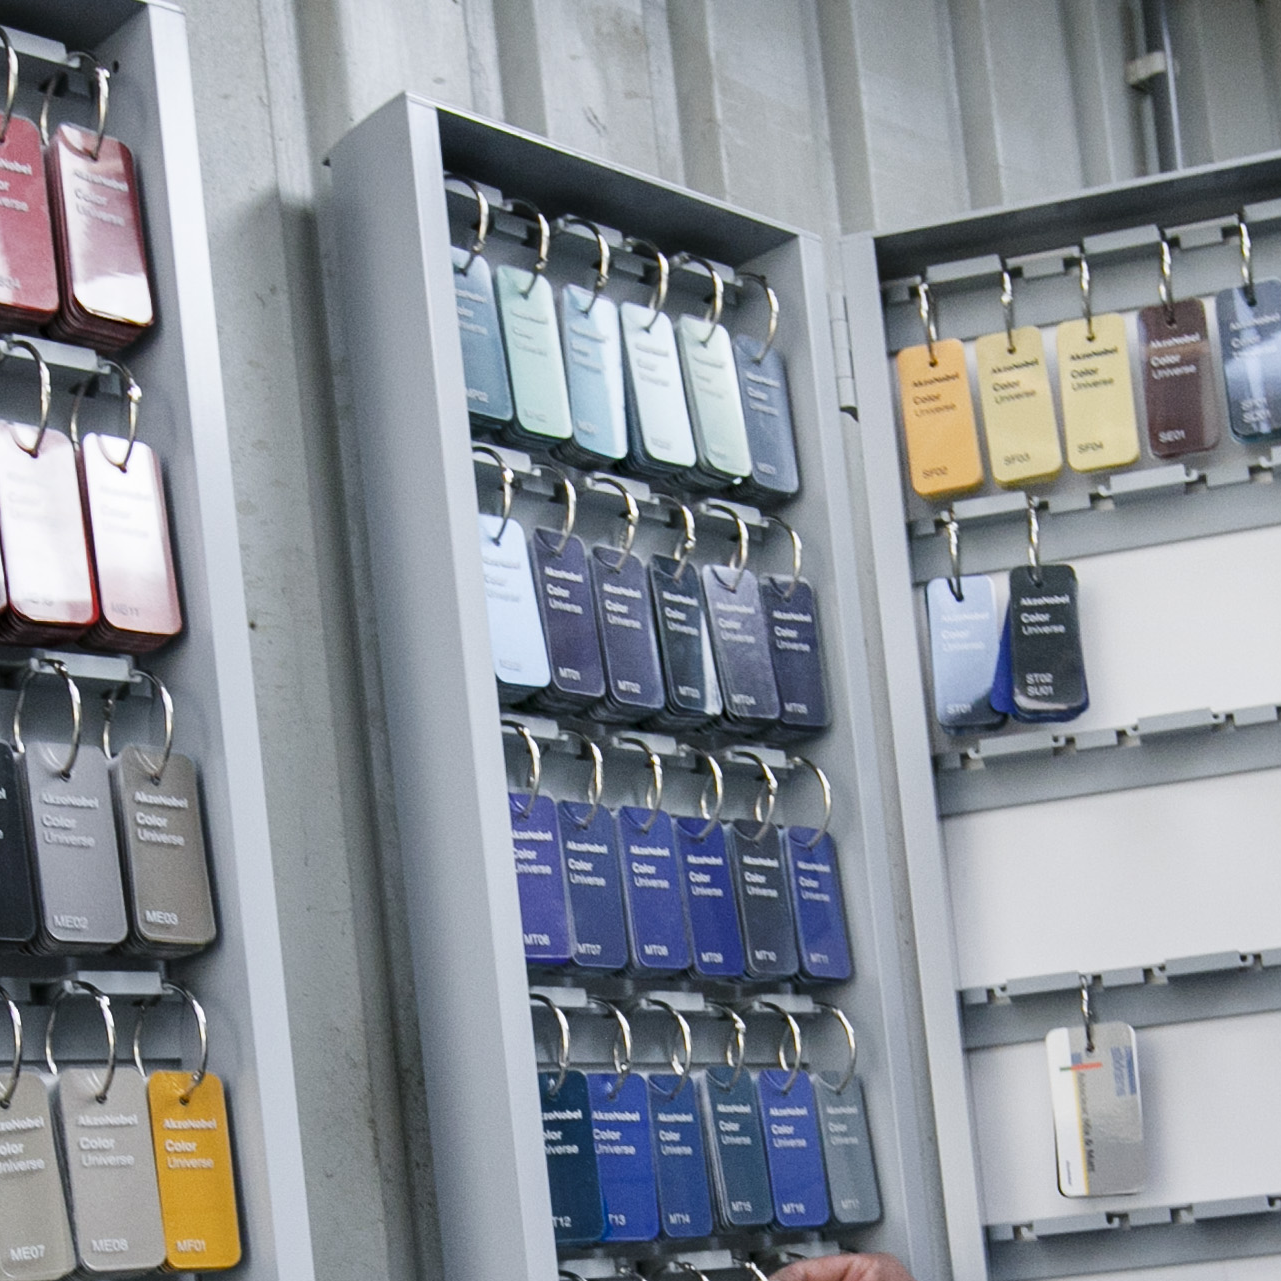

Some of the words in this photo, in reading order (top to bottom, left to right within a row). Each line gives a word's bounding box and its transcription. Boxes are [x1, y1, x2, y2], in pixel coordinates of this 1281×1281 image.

[164, 1118, 216, 1128] AkzoNobel
[166, 1139, 197, 1151] Color
[167, 1157, 214, 1168] Universe
[177, 1239, 206, 1251] MF01
[10, 1244, 45, 1260] ME07
